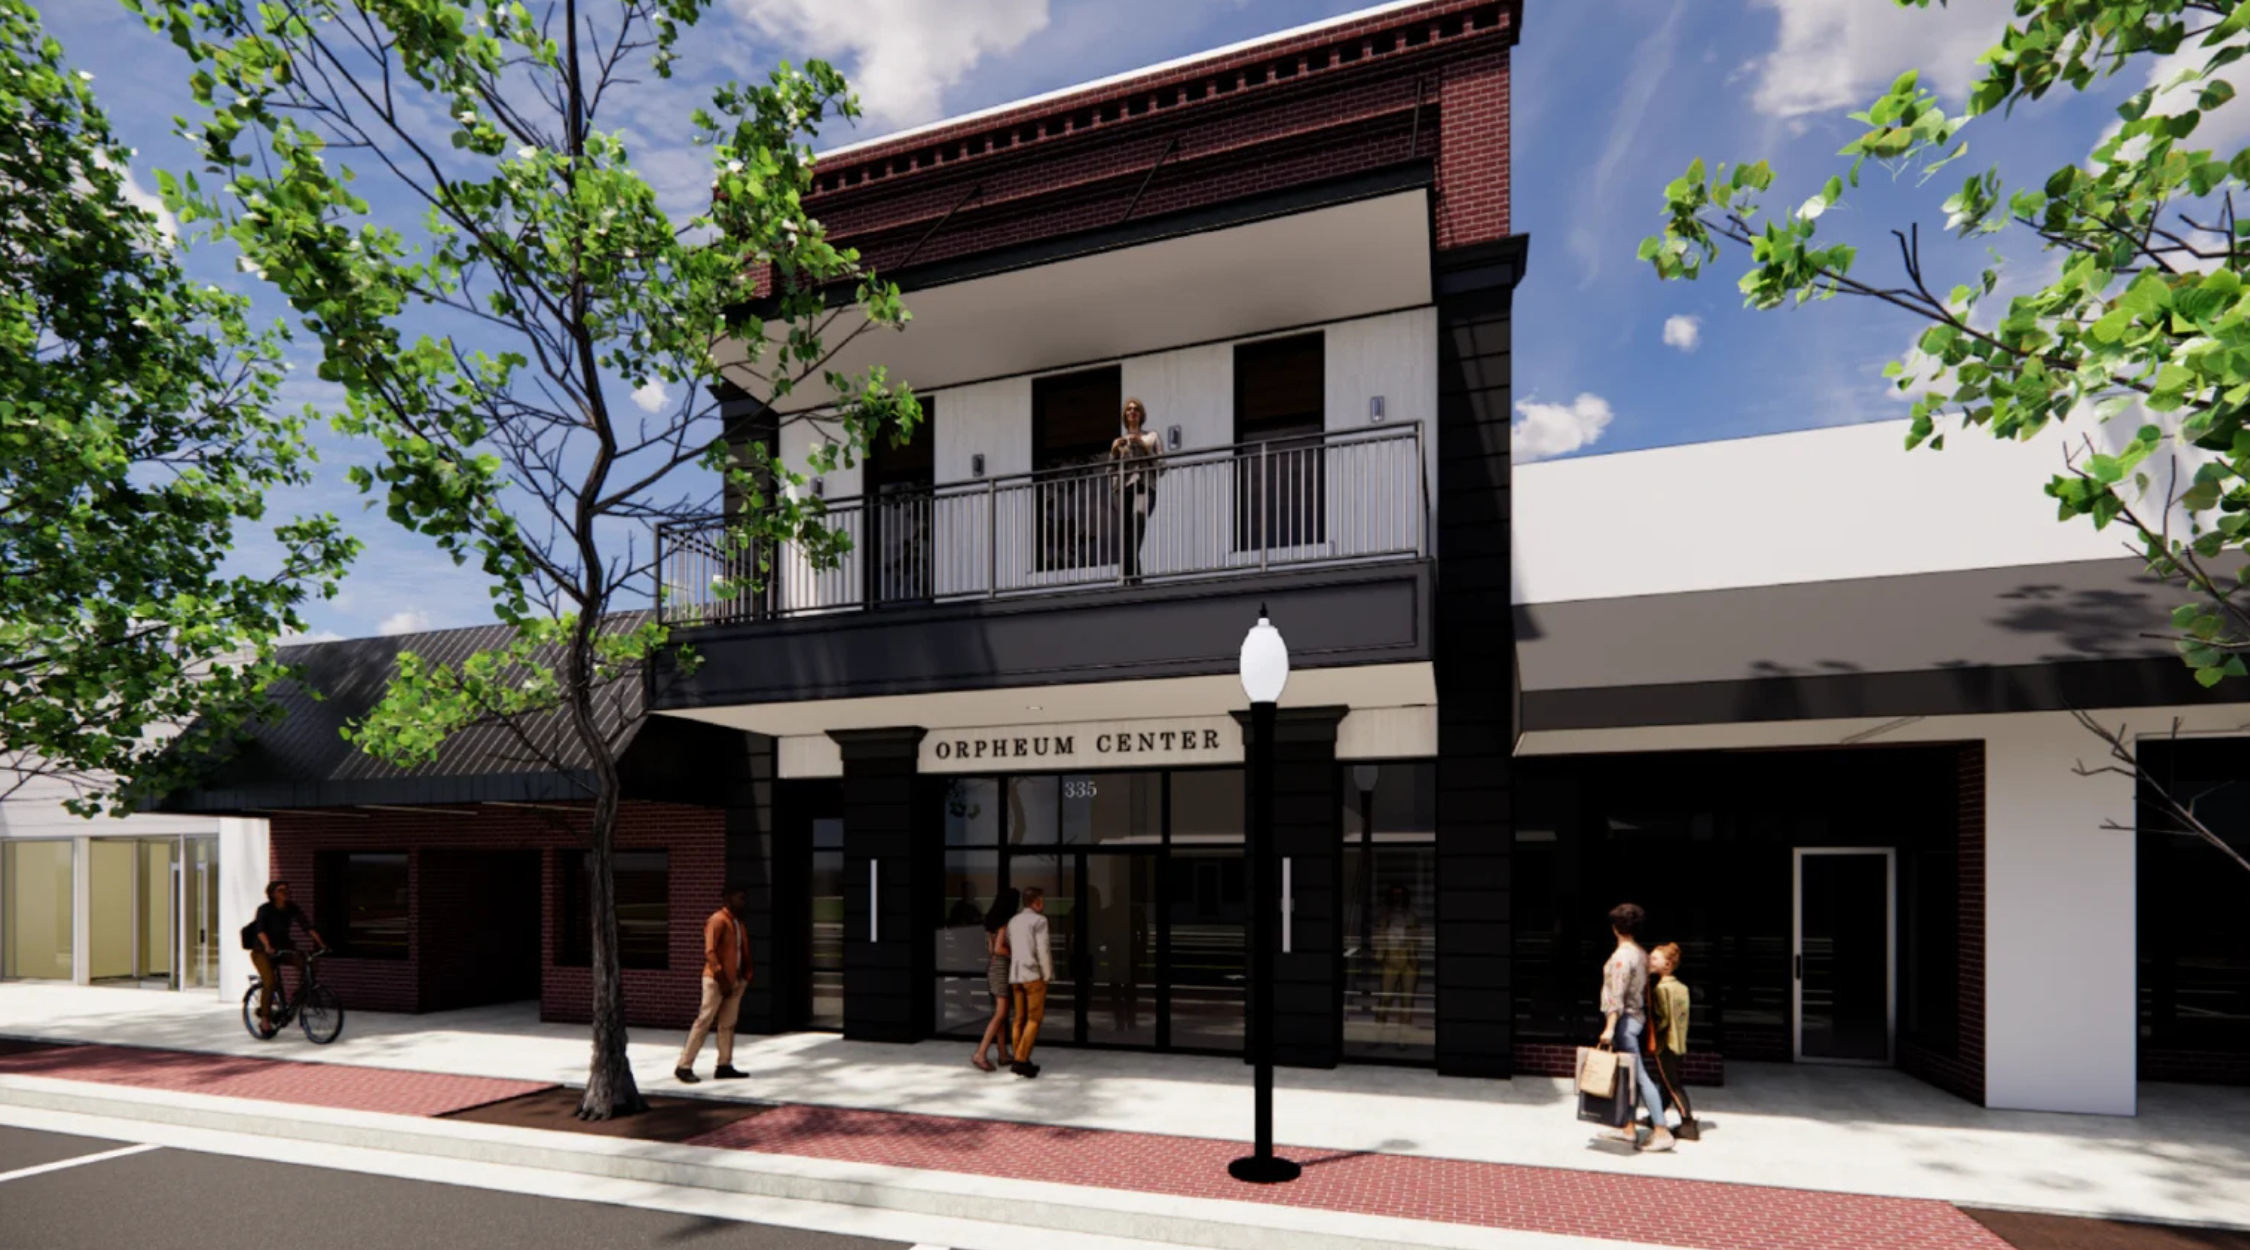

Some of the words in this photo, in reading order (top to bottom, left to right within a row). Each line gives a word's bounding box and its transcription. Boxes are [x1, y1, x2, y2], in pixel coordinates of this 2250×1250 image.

[936, 736, 1074, 759] ORPHEUM
[1096, 729, 1219, 753] CENTER
[1064, 781, 1097, 798] 335
